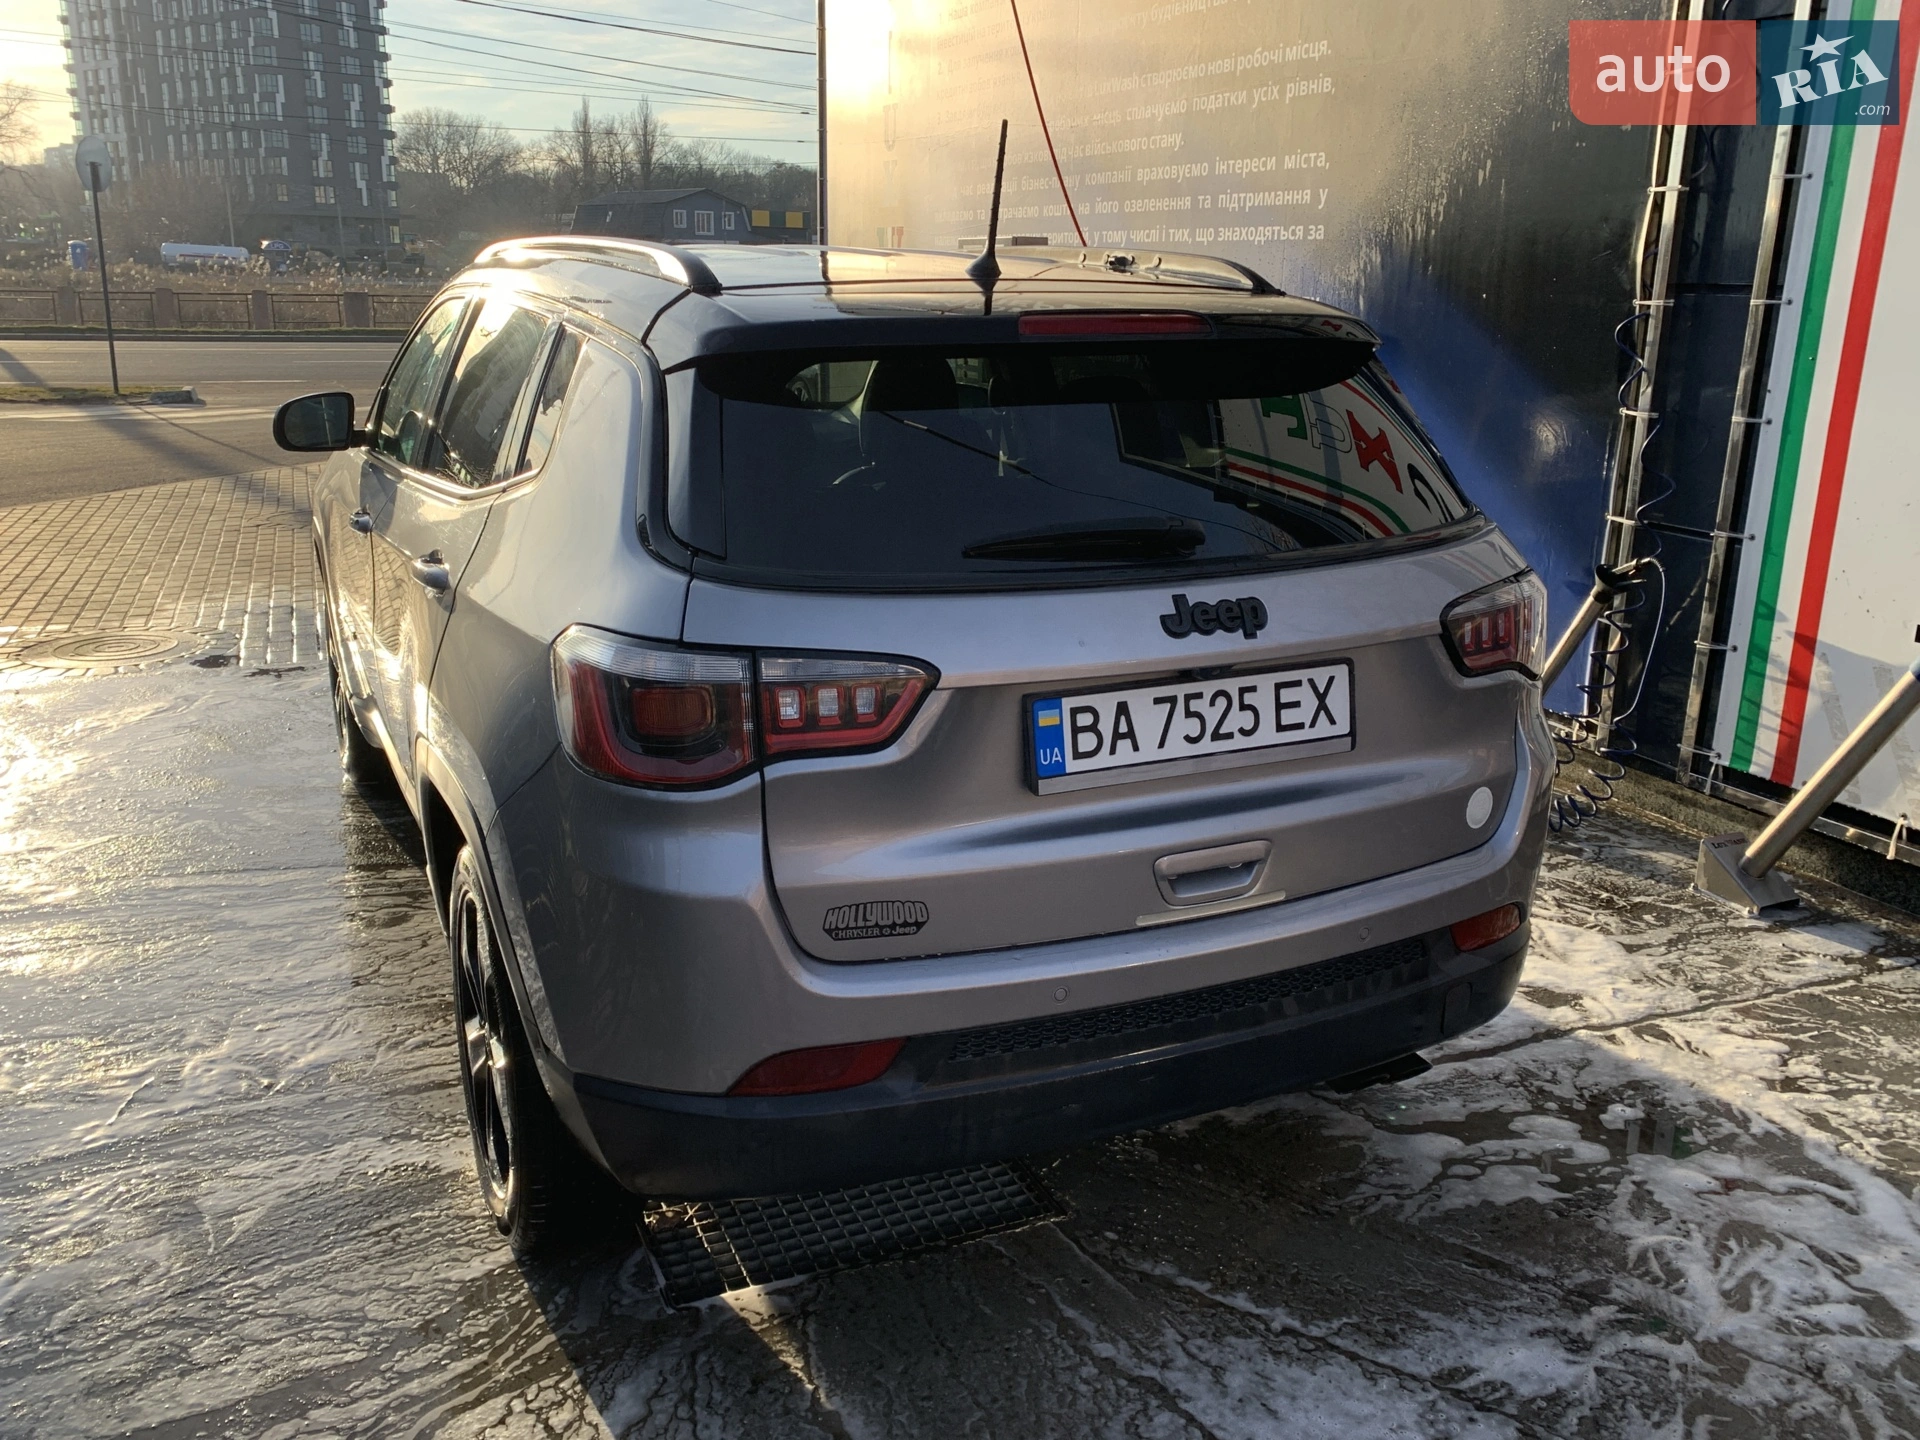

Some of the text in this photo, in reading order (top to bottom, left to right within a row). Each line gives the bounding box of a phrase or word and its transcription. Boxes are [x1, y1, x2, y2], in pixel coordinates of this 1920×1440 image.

[1140, 62, 1206, 88] створюємо
[1207, 53, 1236, 76] нові
[1237, 43, 1284, 76] робочі
[1285, 40, 1332, 62] місця.
[1126, 99, 1187, 121] сплачуємо
[1192, 90, 1247, 114] податки
[1252, 81, 1280, 108] усіх
[1286, 73, 1335, 104] рівнів,
[1085, 137, 1148, 157] військового
[1149, 132, 1184, 151] стану.
[1085, 165, 1132, 186] компанії
[1137, 161, 1209, 186] враховуємо
[1215, 156, 1276, 179] інтереси
[1284, 149, 1330, 170] міста,
[1078, 202, 1090, 215] на
[1095, 197, 1119, 215] його
[1124, 195, 1191, 213] озеленення
[1197, 194, 1211, 209] та
[1218, 189, 1311, 212] підтримання
[1318, 188, 1329, 210] у
[1102, 229, 1128, 247] тому
[1130, 225, 1159, 242] числі
[1168, 227, 1192, 244] тих,
[1195, 227, 1215, 245] що
[1217, 224, 1304, 245] знаходяться
[1307, 224, 1325, 240] за
[1159, 594, 1269, 639] Jeep
[1069, 675, 1338, 760] BA 7525 EX
[1040, 747, 1063, 765] UA
[824, 900, 929, 930] HOLLYWOOD
[832, 926, 917, 939] CHRYSLER Jeep
